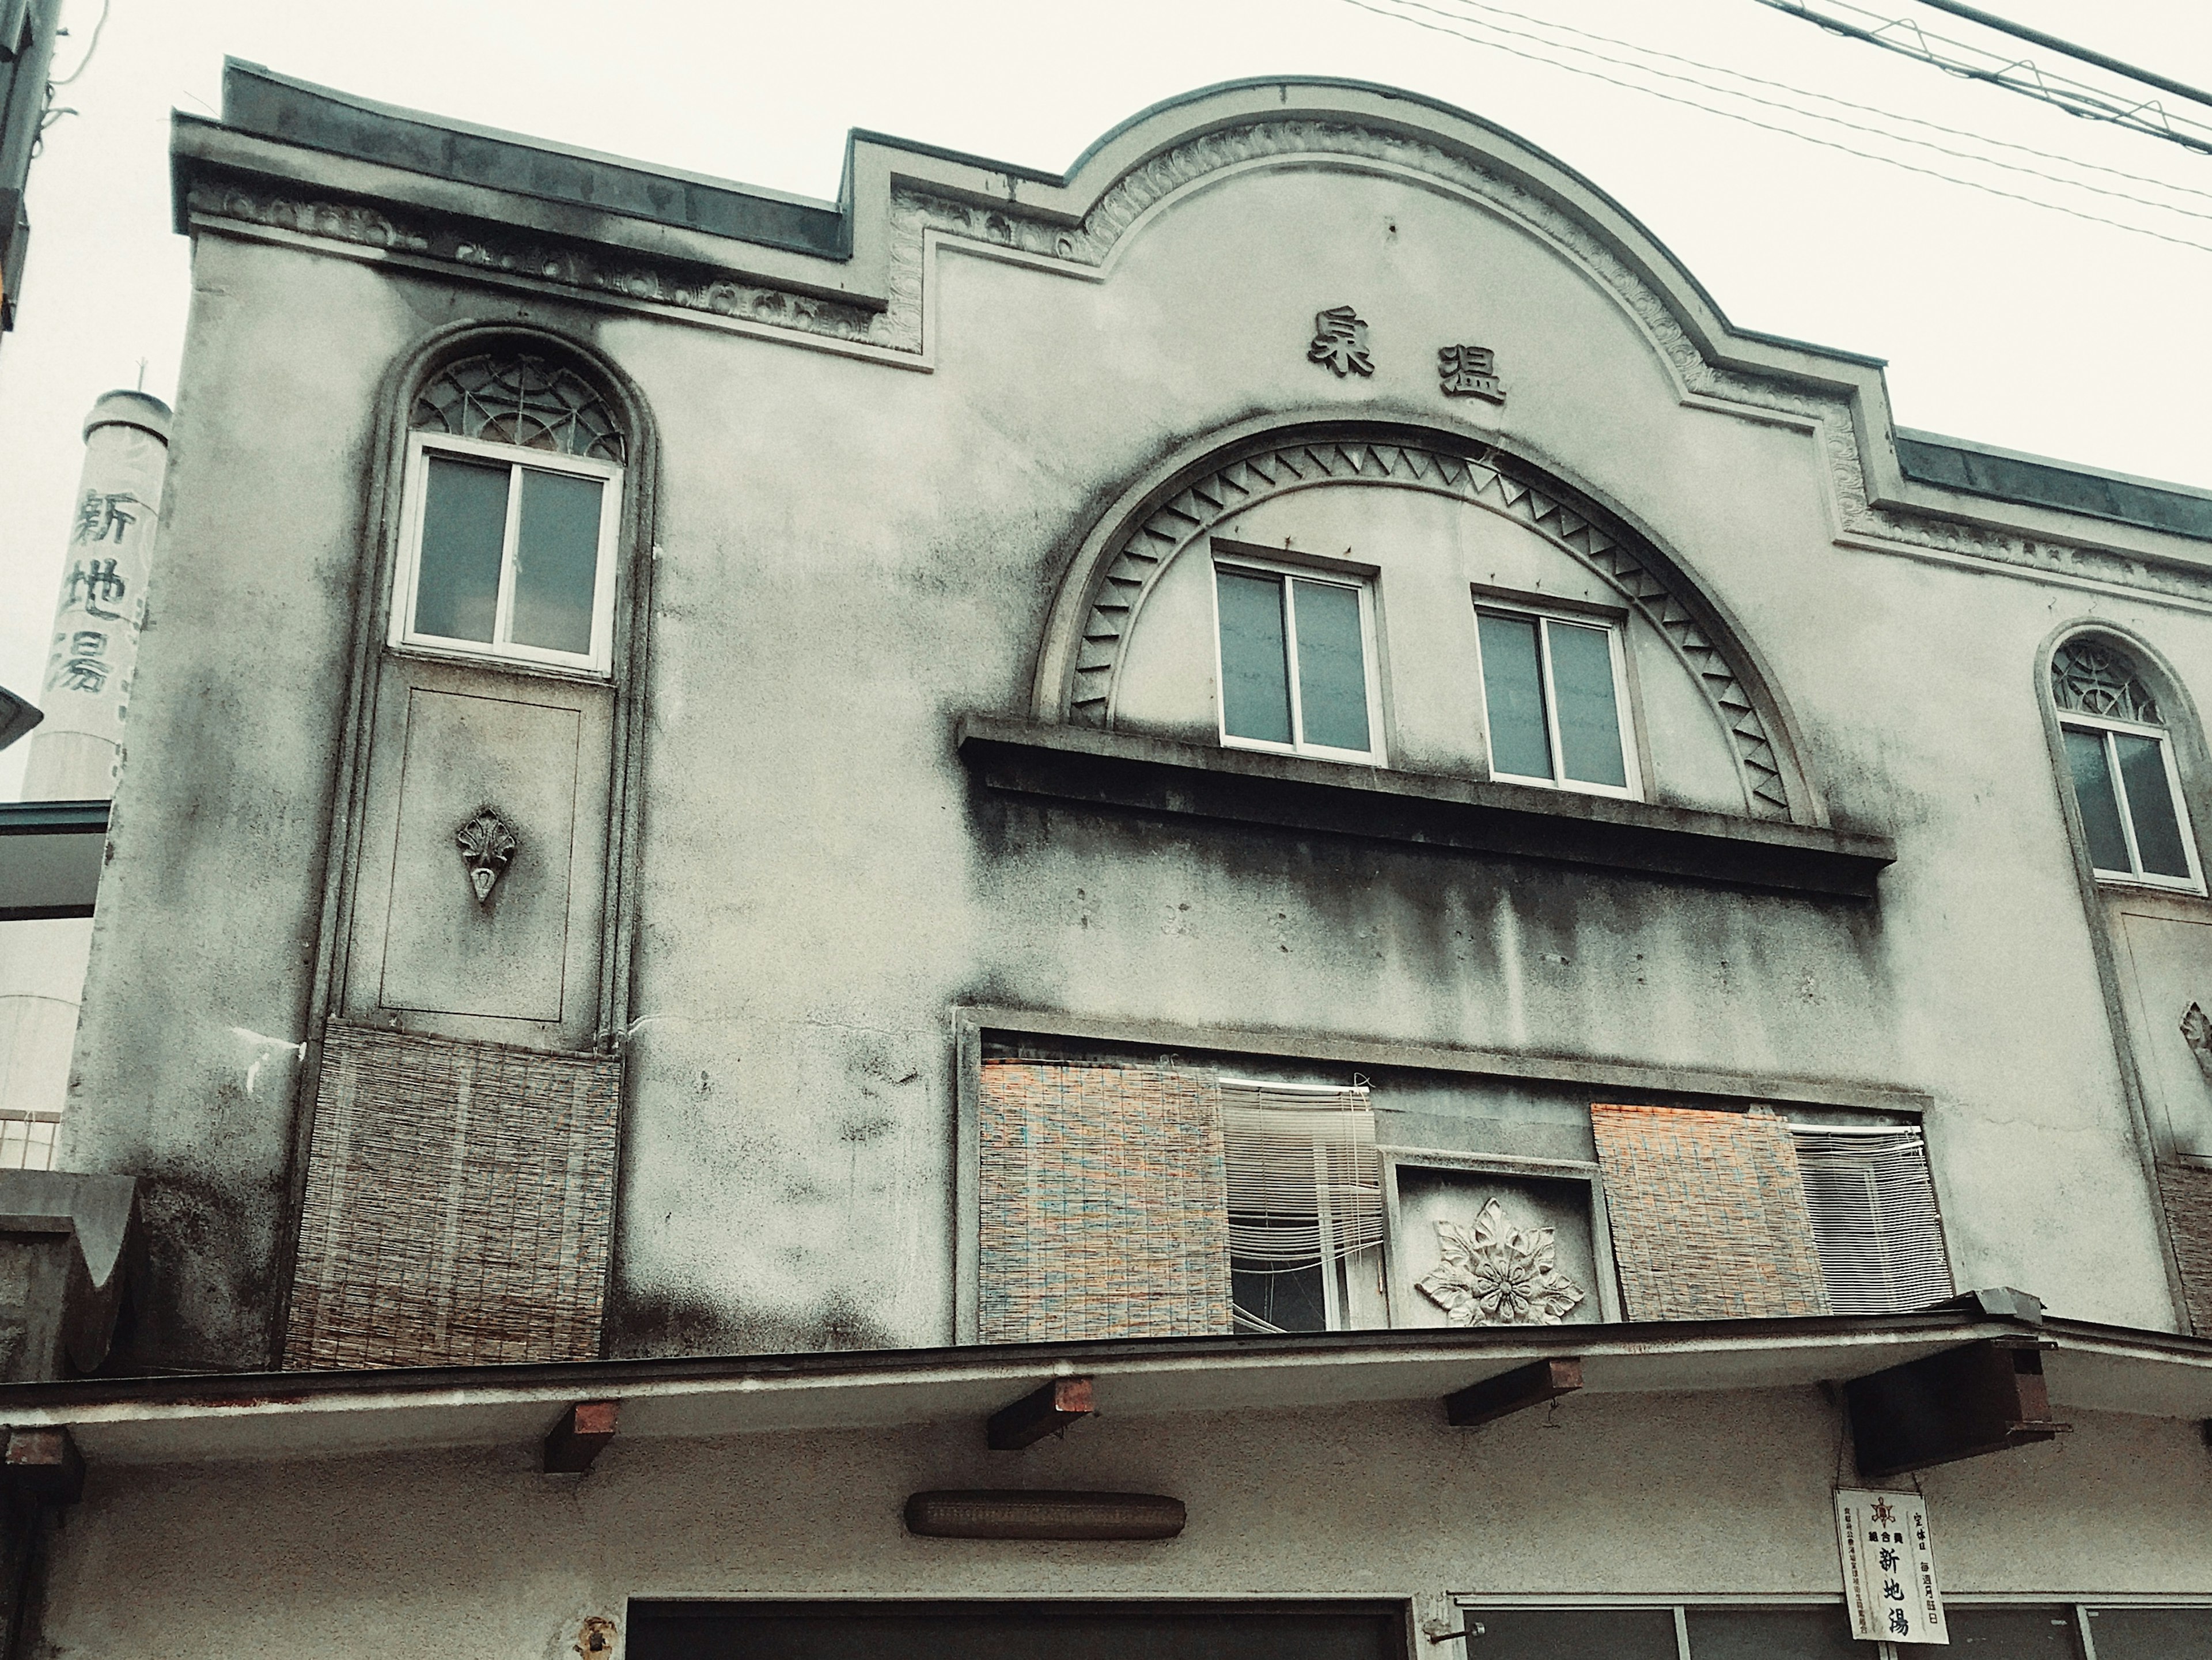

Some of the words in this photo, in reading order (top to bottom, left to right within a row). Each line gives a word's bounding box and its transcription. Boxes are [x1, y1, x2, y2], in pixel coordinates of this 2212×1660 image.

[46, 488, 137, 693] 新地湯
[1868, 1532, 1904, 1544] 組合員
[1914, 1512, 1926, 1550] 定休日
[1879, 1547, 1908, 1636] 新地湯
